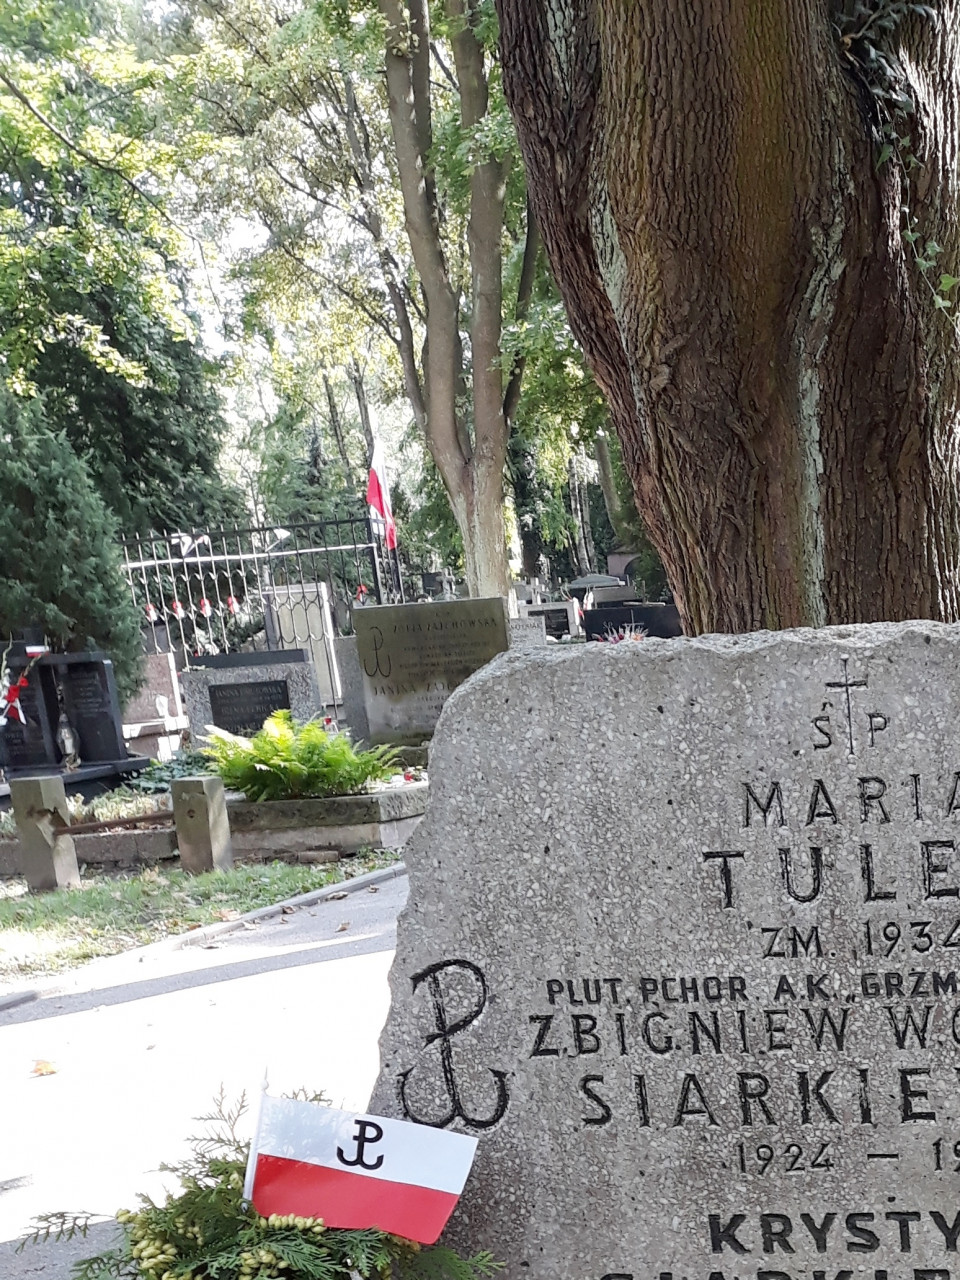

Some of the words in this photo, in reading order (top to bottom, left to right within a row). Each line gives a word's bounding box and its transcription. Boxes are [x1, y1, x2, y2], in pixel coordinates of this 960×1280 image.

[866, 712, 891, 748] P
[761, 924, 836, 959] ZM.
[528, 1006, 851, 1058] ZBIGNIEW
[734, 1142, 835, 1176] 1924
